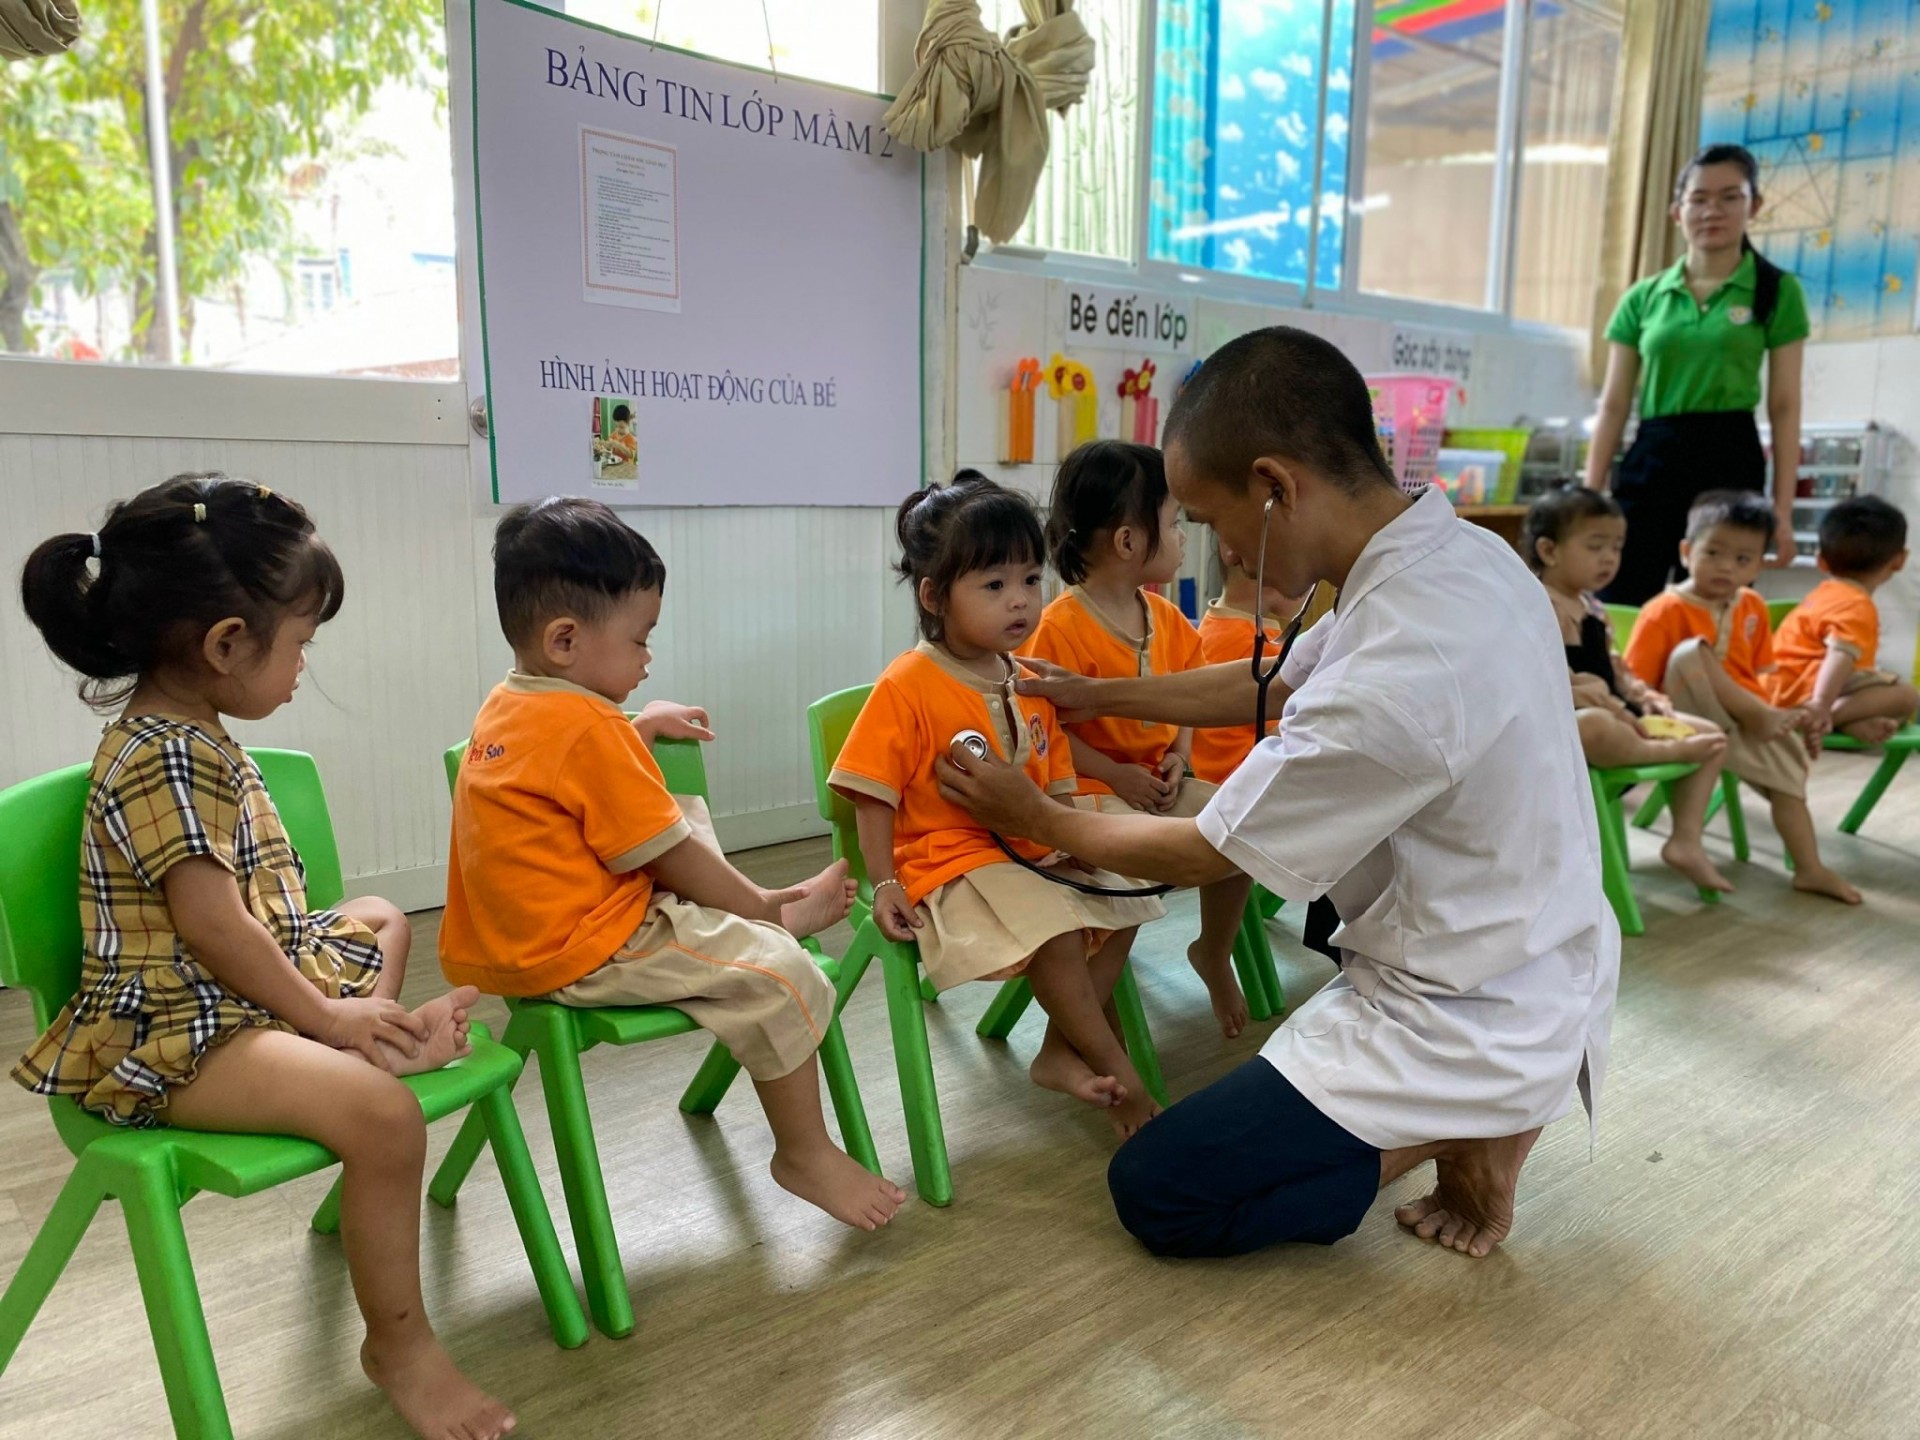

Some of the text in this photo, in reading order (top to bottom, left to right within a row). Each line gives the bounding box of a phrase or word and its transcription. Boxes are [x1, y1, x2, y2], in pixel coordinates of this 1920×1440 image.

[545, 45, 893, 157] BẢNG TIN LỚP MẦM 2
[1070, 293, 1187, 350] Bé đến lớp
[540, 355, 837, 407] HÌNH ẢNH HOẠT ĐỘNG CỦA BÉ
